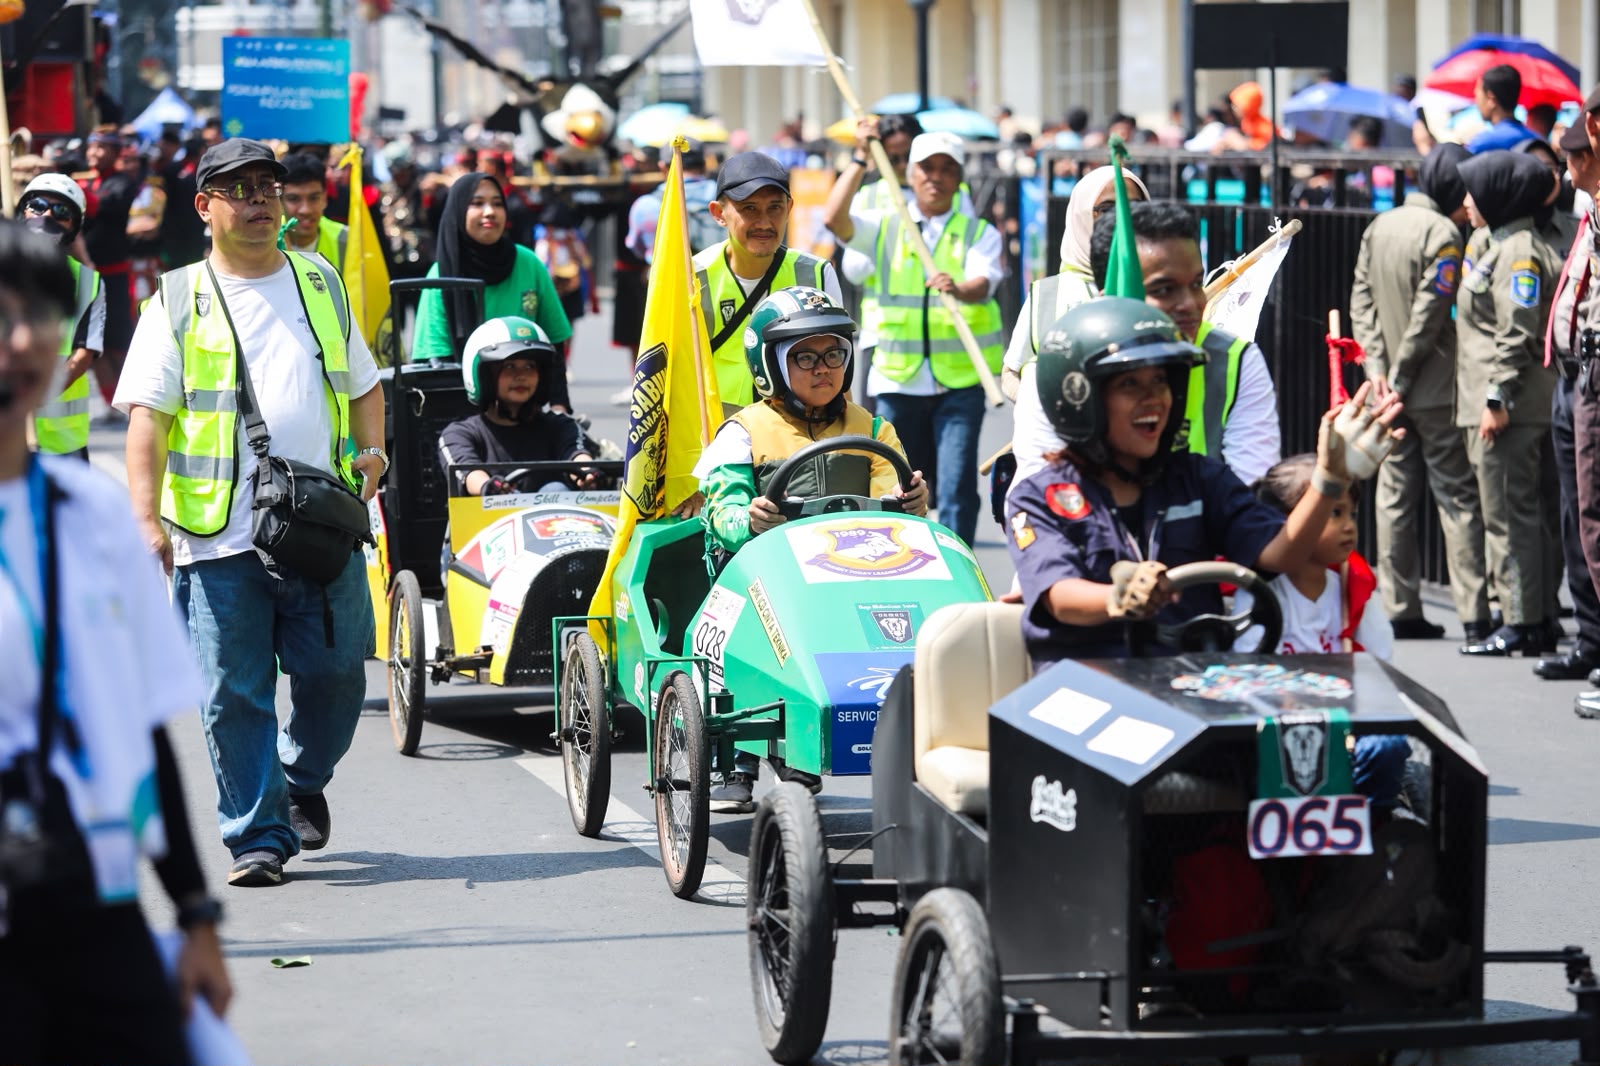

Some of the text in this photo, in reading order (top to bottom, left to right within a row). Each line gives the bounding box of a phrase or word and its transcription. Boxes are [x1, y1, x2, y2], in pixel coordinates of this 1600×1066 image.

[629, 405, 662, 444] DAMAS
[483, 498, 517, 509] Smart
[533, 494, 559, 505] Skill
[575, 491, 621, 504] Competen
[834, 529, 866, 538] 1989
[696, 621, 726, 661] 028
[1251, 797, 1367, 855] 065
